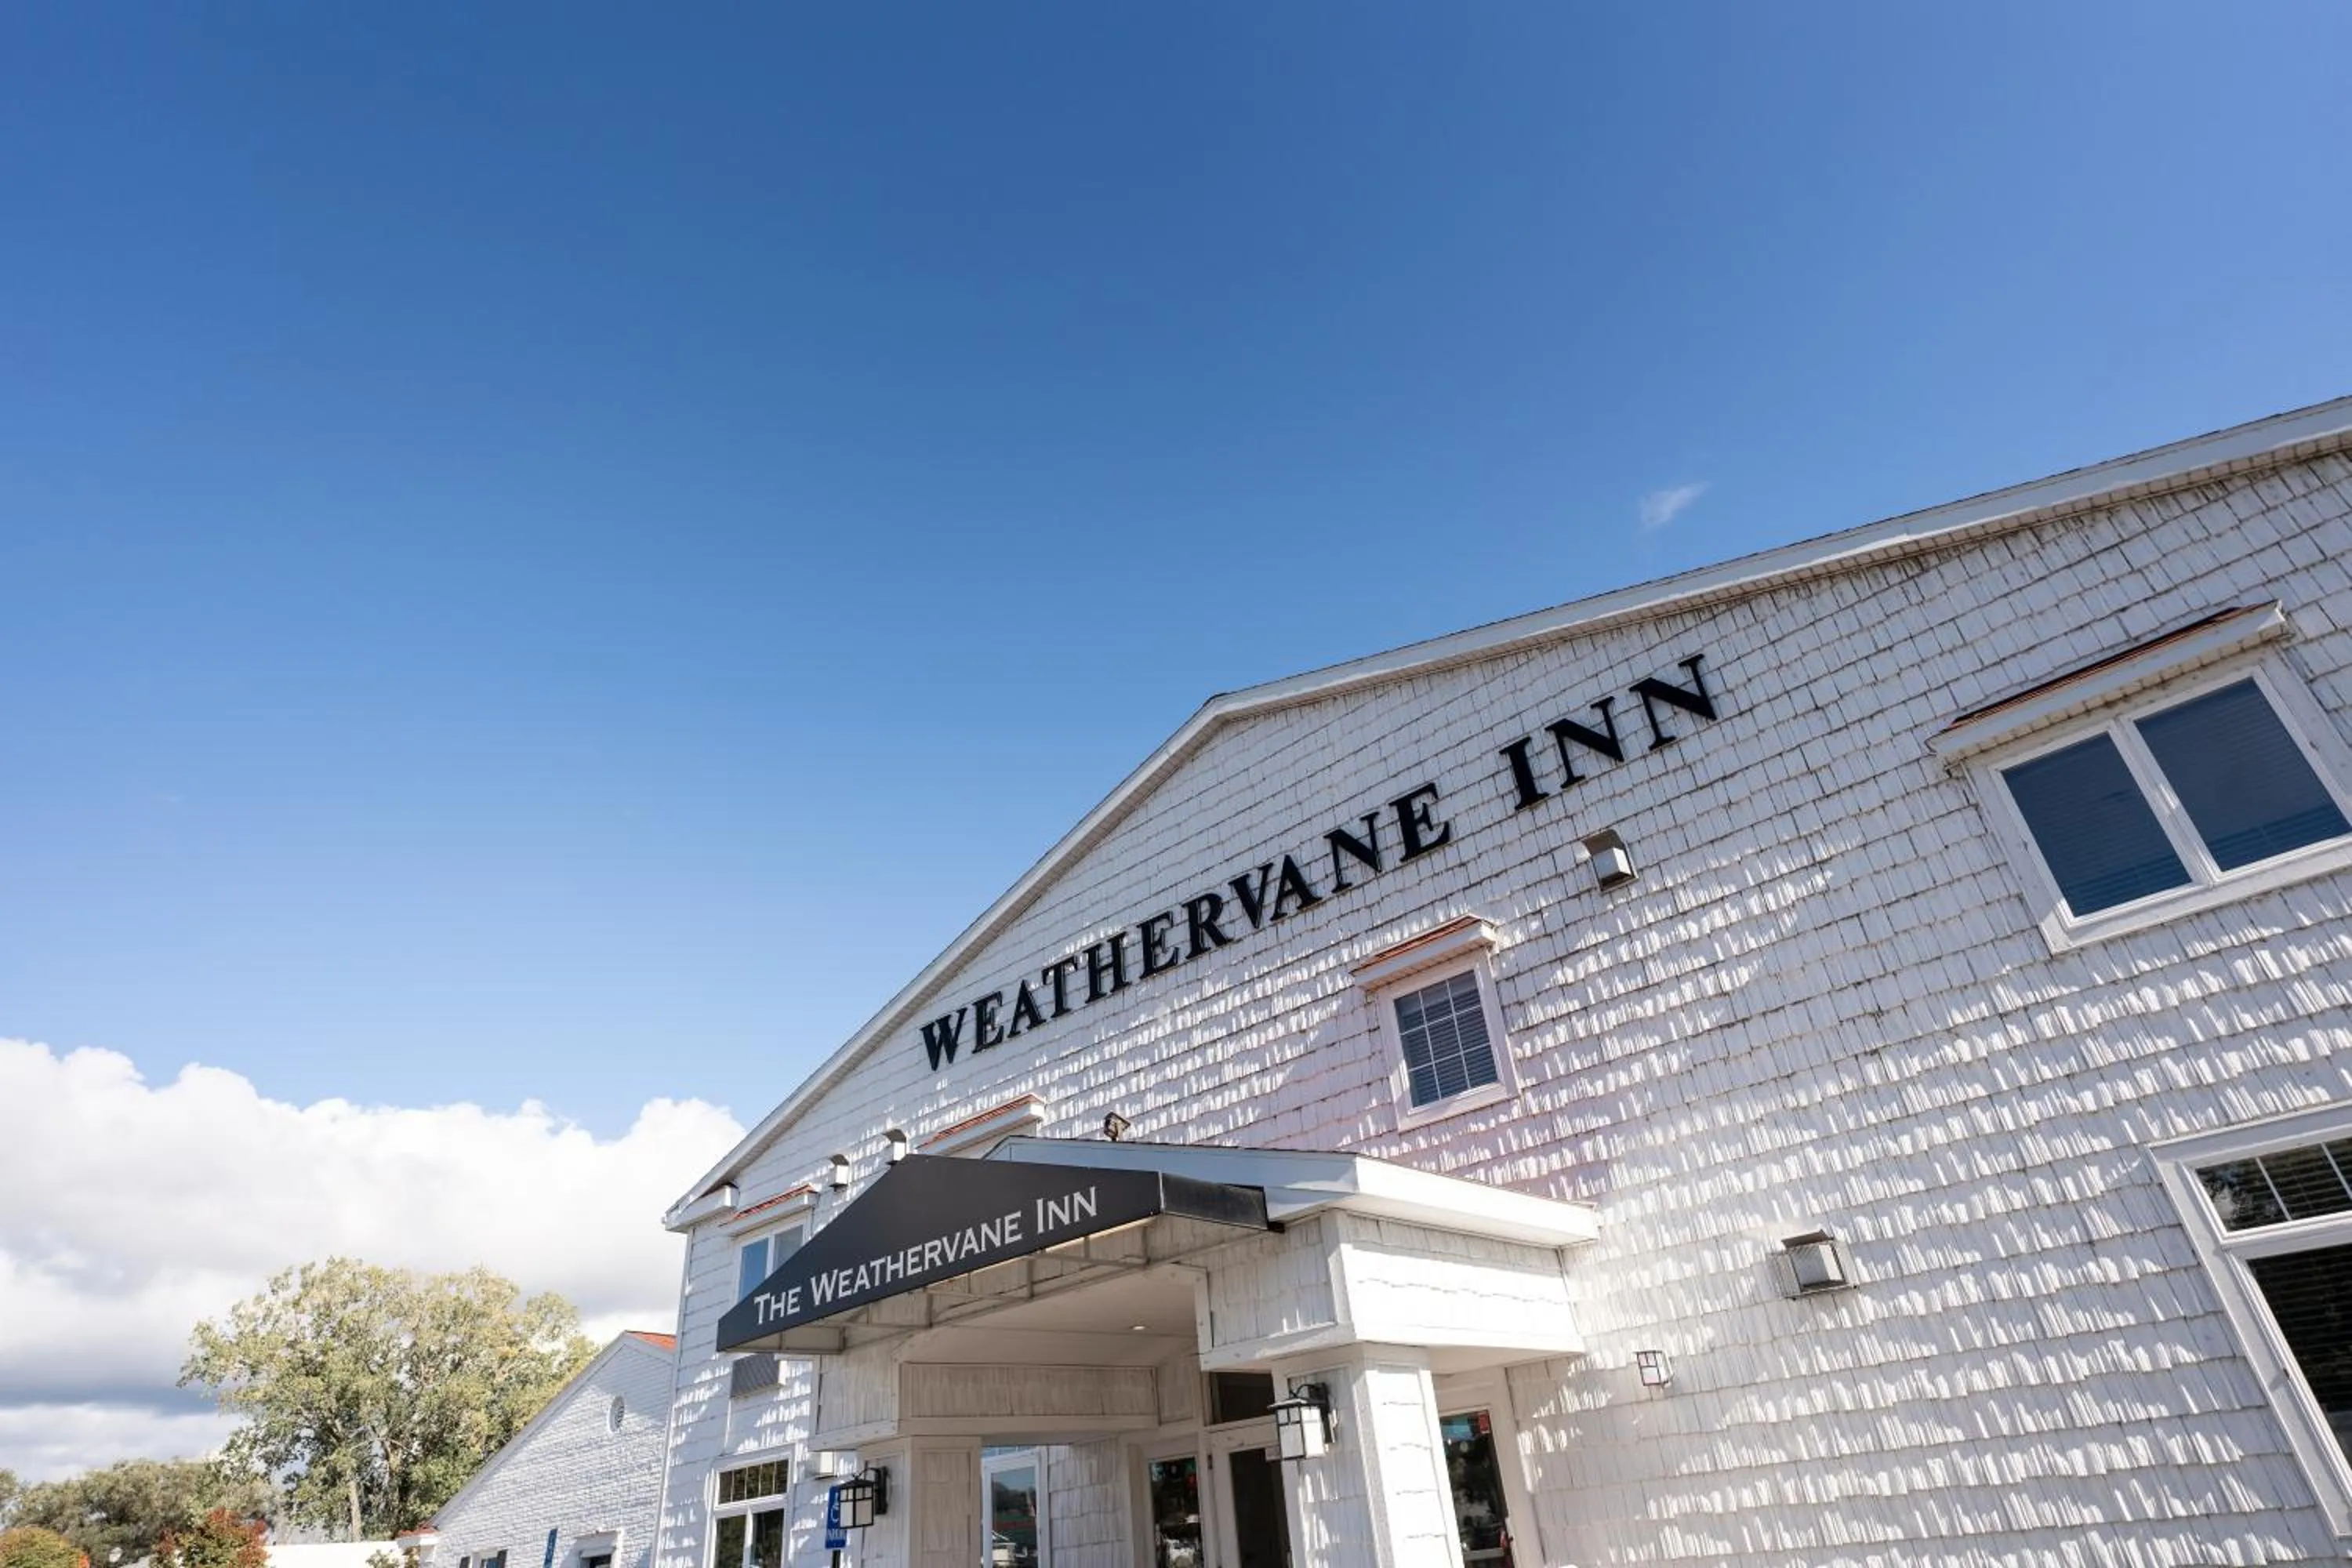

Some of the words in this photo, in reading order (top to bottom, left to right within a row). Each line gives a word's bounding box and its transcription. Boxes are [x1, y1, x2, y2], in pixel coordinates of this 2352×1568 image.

[921, 782, 1451, 1072] WEATHERVANE
[1499, 653, 1717, 811] INN
[754, 1287, 800, 1324] THE
[811, 1211, 1022, 1306] WEATHERVANE
[1036, 1186, 1098, 1234] INN
